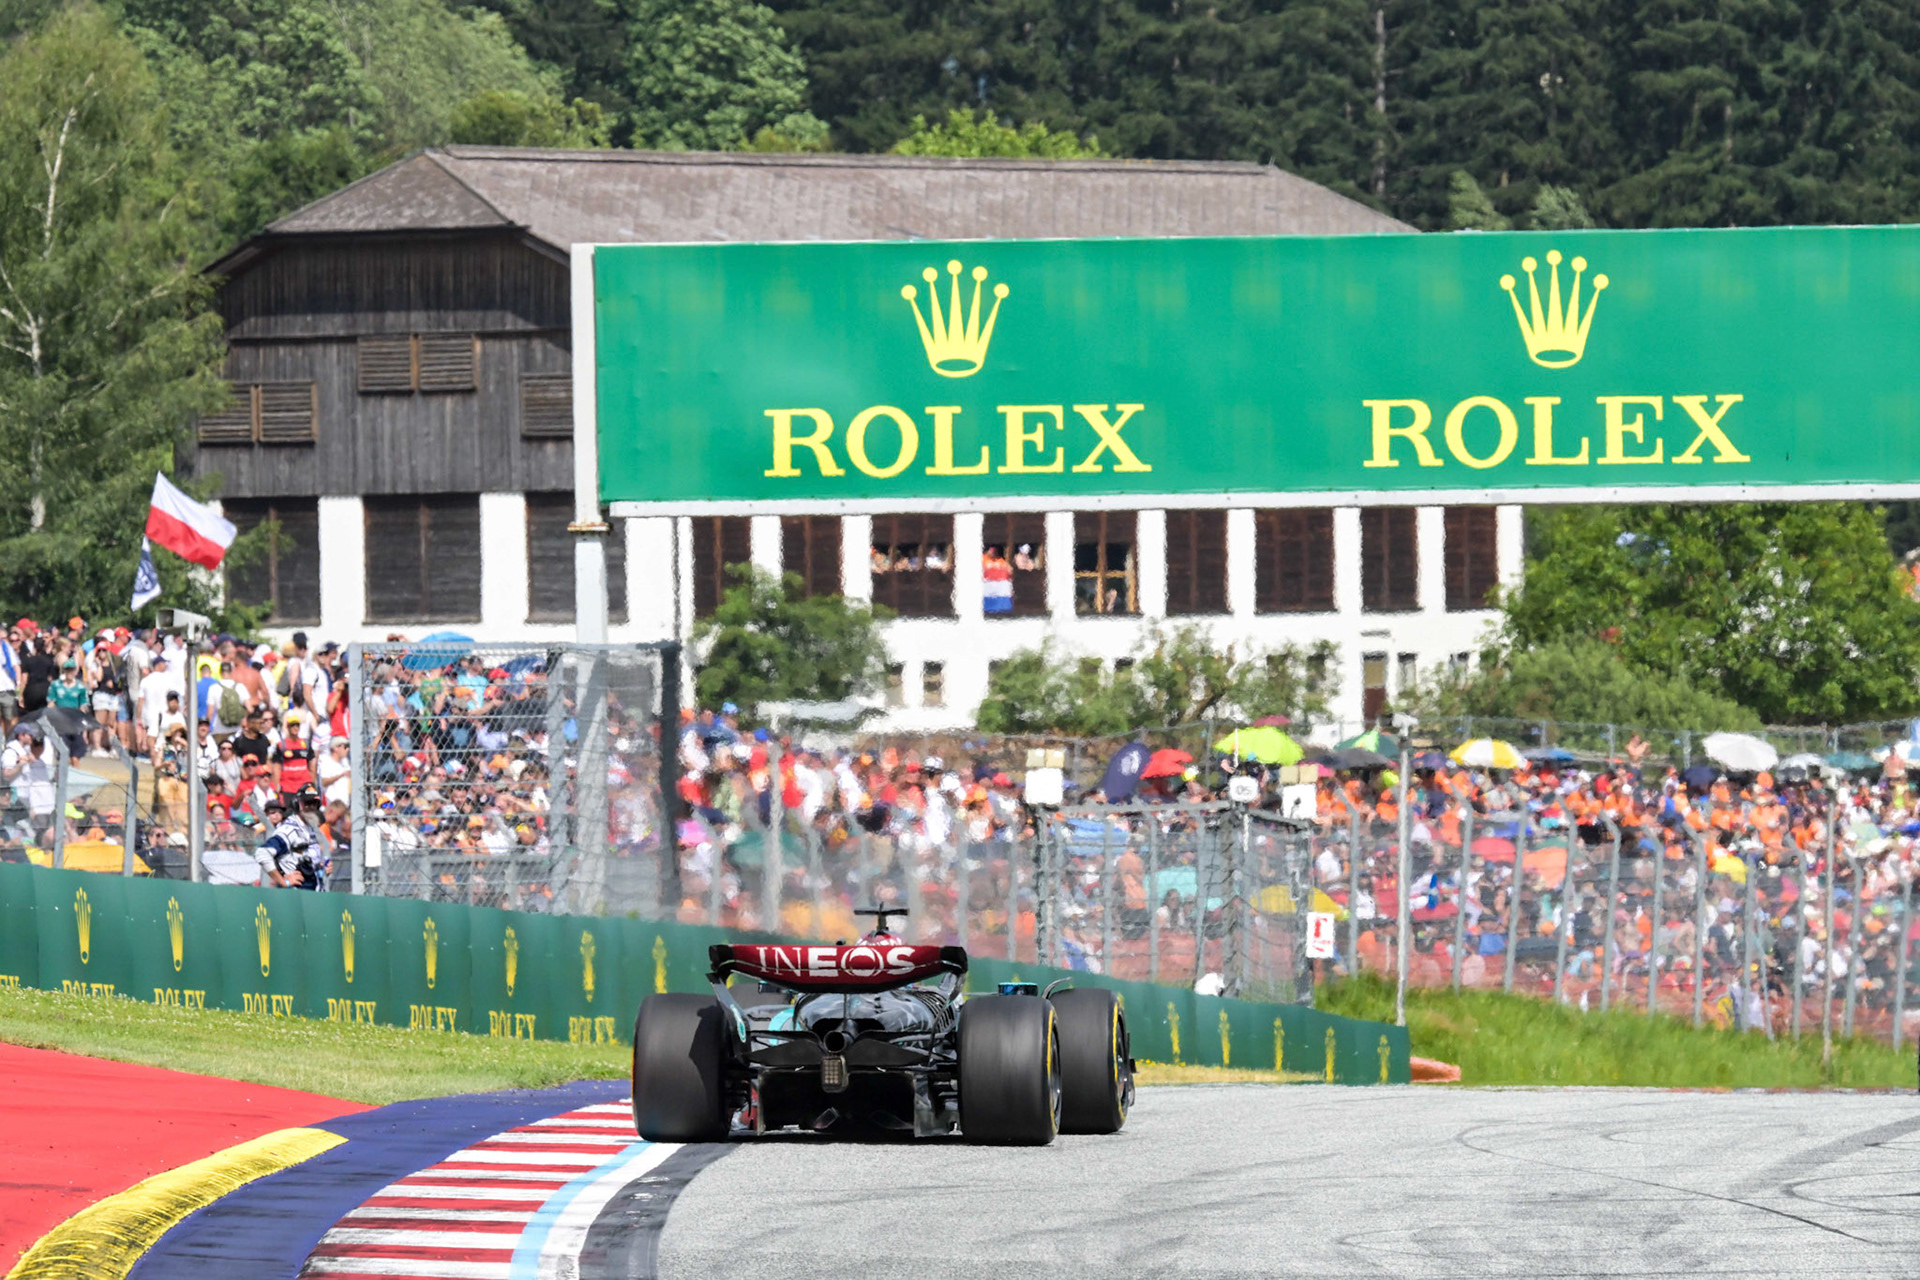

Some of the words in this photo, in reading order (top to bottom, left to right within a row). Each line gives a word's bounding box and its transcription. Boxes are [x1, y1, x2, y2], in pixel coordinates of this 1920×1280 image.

[763, 402, 1153, 479] ROLEX
[1363, 393, 1751, 469] ROLEX
[756, 946, 916, 978] INEOS
